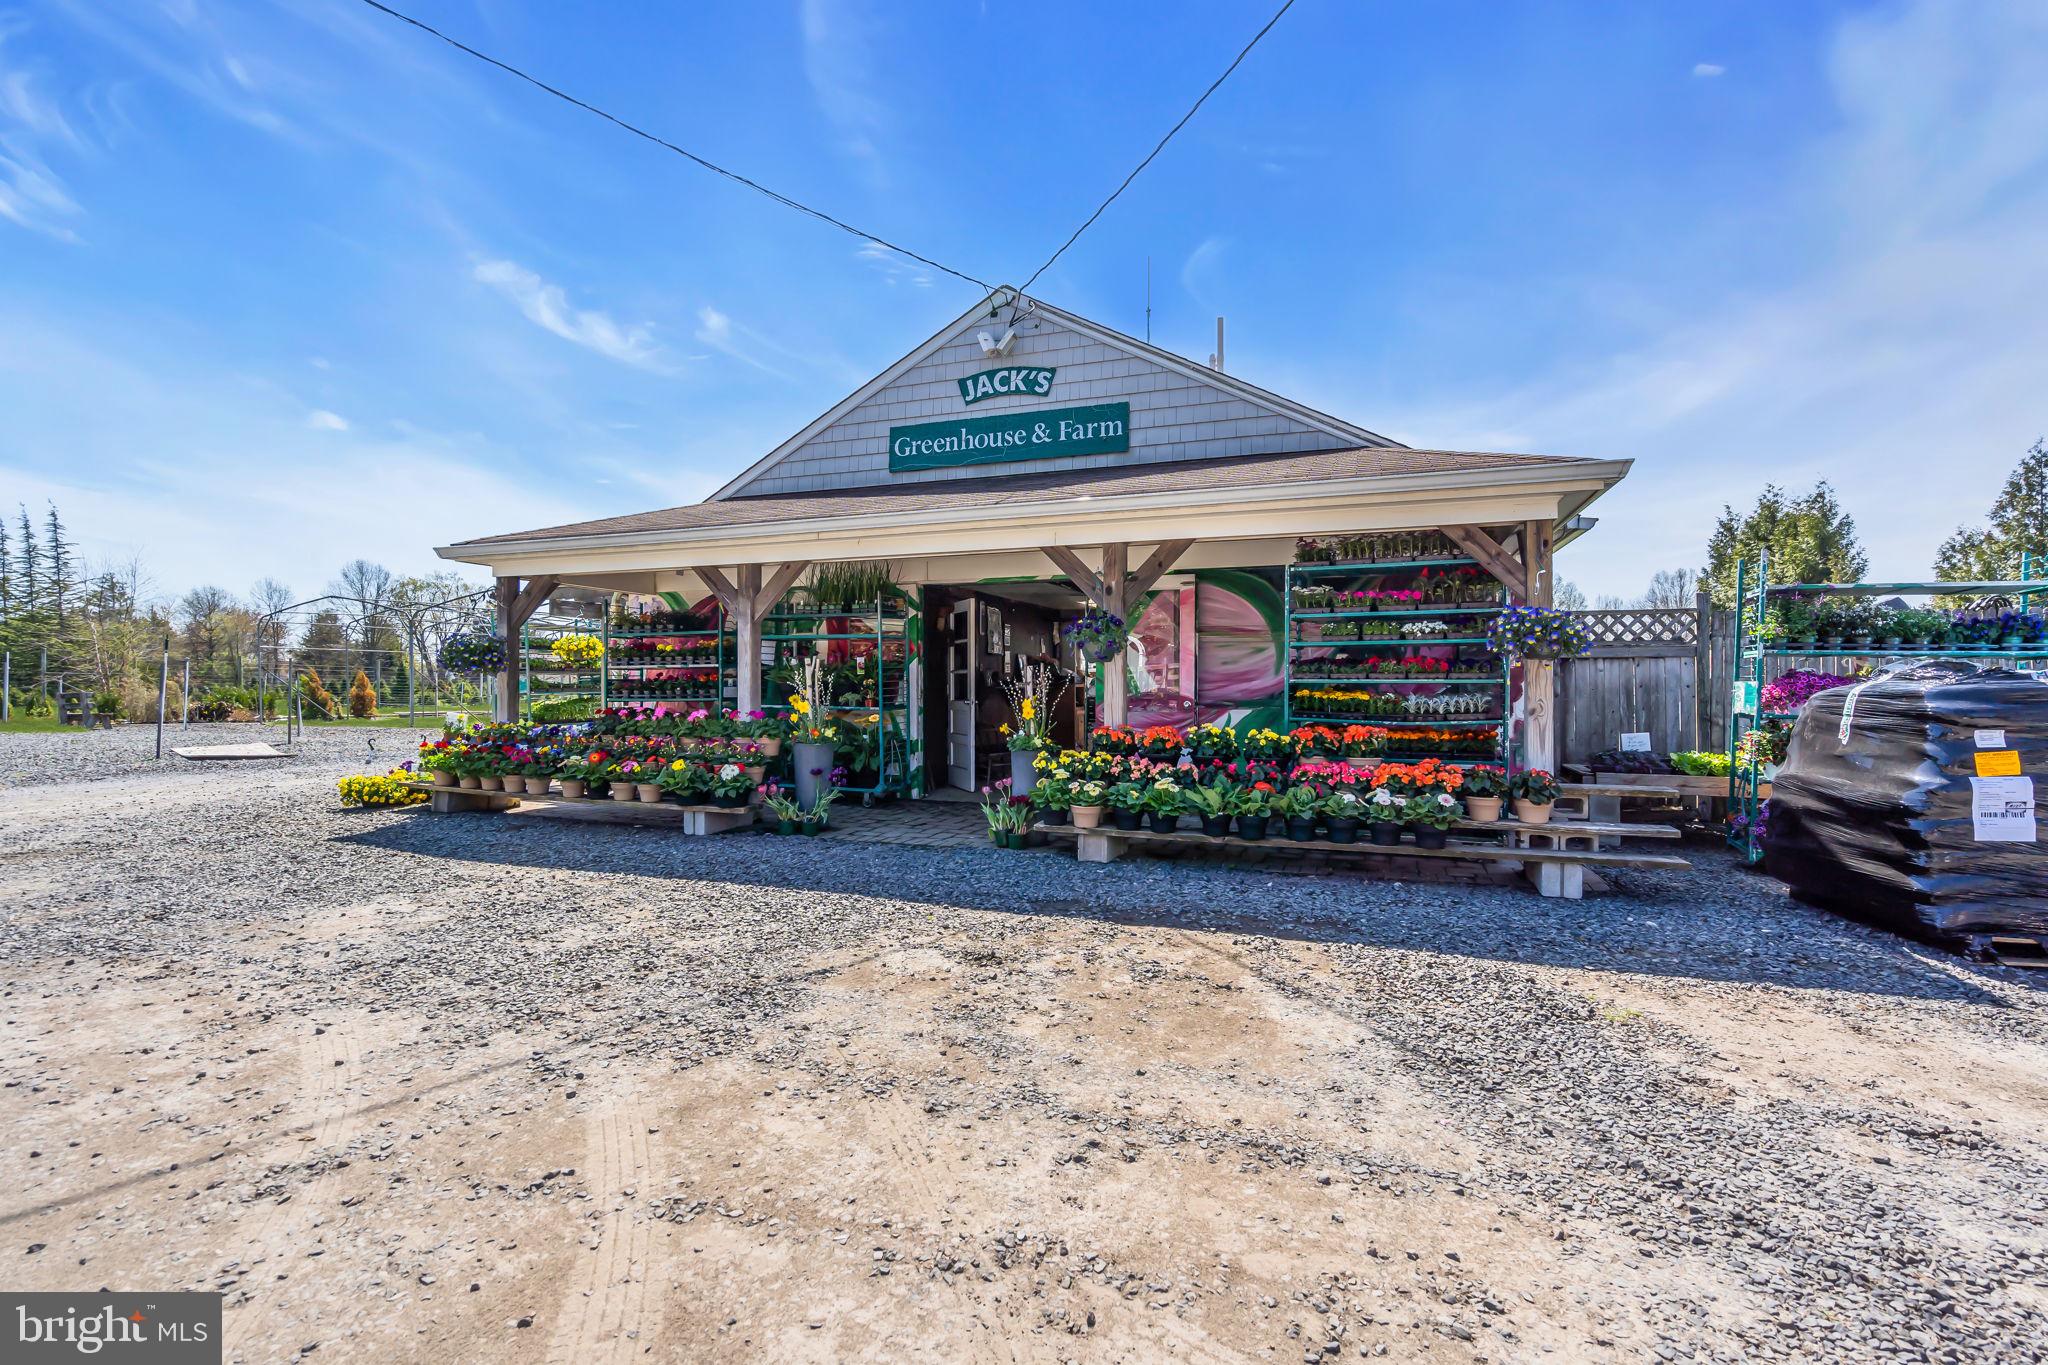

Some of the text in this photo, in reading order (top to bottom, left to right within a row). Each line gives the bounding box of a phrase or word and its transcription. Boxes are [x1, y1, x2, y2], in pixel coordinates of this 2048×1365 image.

[965, 369, 1052, 401] JACK'S
[894, 420, 1124, 457] Greenhouse & Farm
